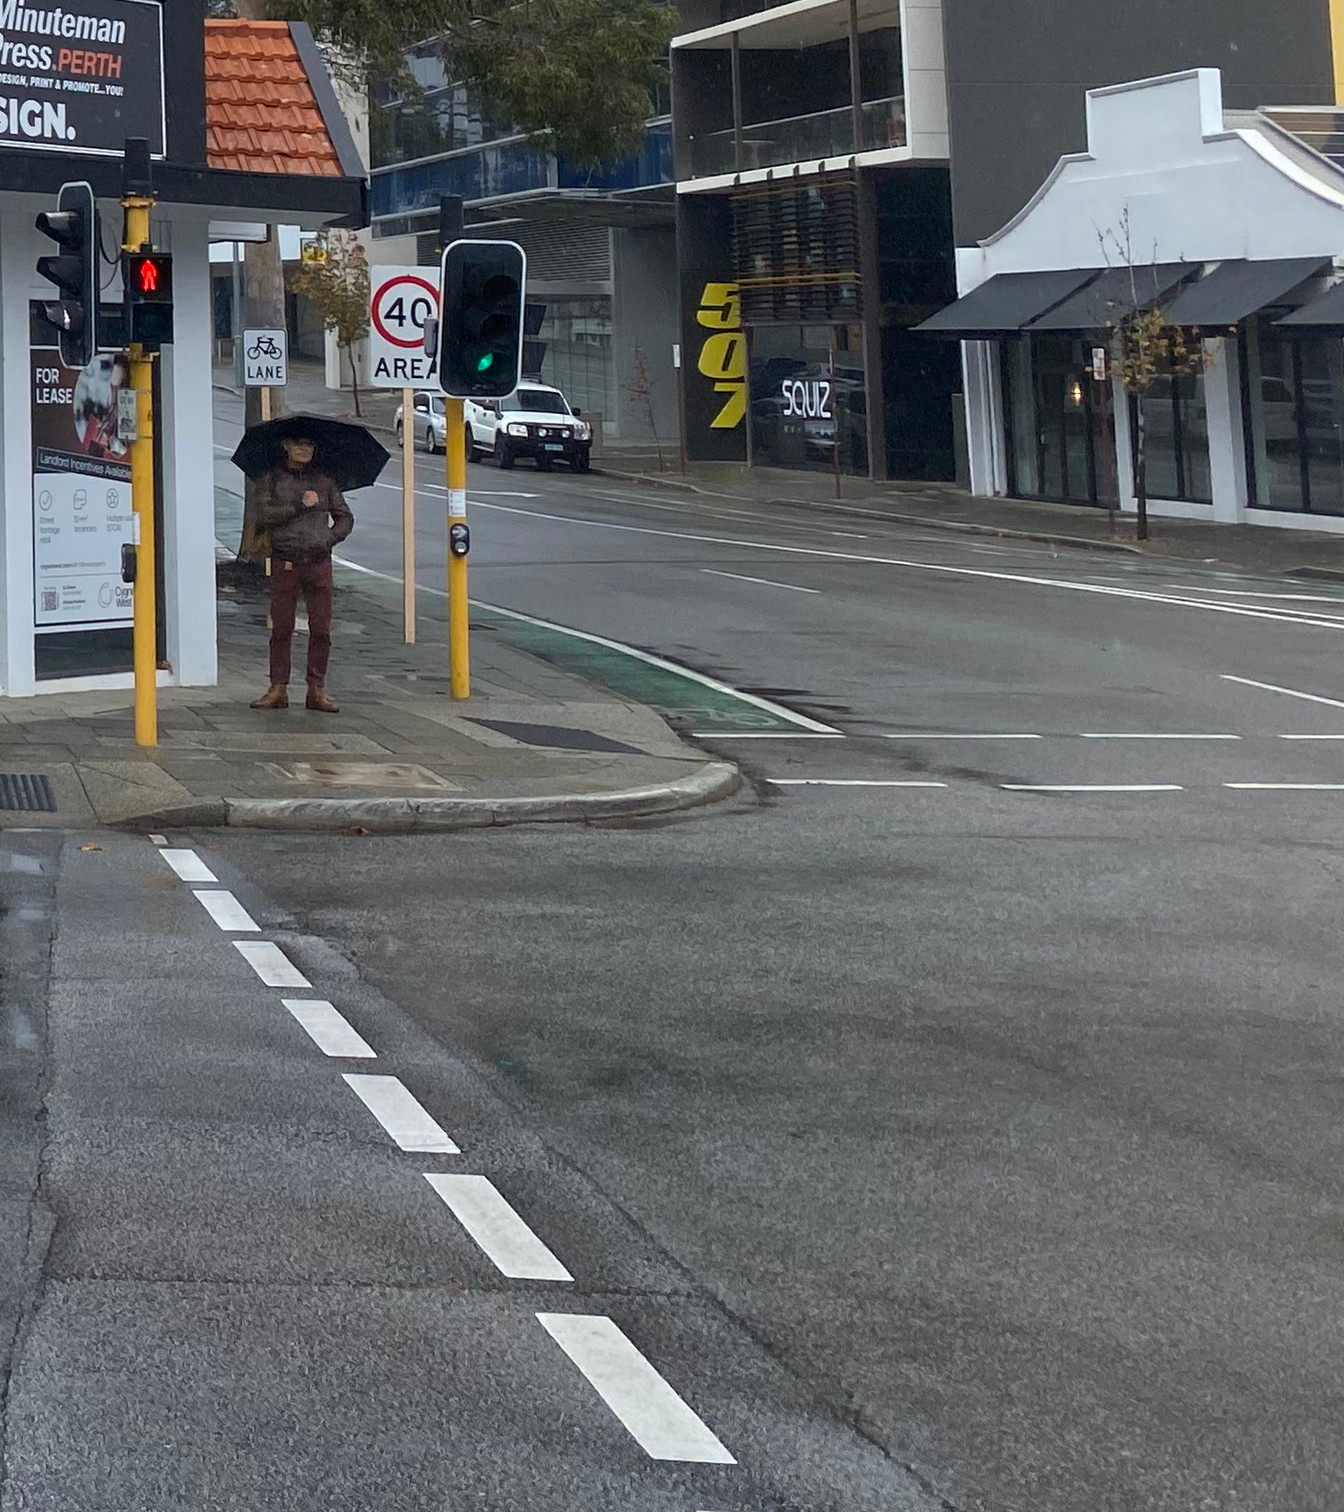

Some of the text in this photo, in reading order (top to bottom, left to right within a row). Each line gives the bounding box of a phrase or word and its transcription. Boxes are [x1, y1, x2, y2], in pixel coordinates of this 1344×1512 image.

[58, 48, 122, 79] PERTH
[30, 76, 54, 89] PRINT
[55, 79, 61, 90] &
[384, 296, 432, 329] 40
[696, 283, 748, 428] 507
[35, 367, 60, 384] FOR
[247, 365, 283, 379] LANE
[374, 356, 438, 381] AREA
[35, 388, 73, 404] LEASE
[781, 379, 832, 419] SQUIZ
[39, 452, 70, 468] Landlord
[70, 459, 104, 474] Incentives
